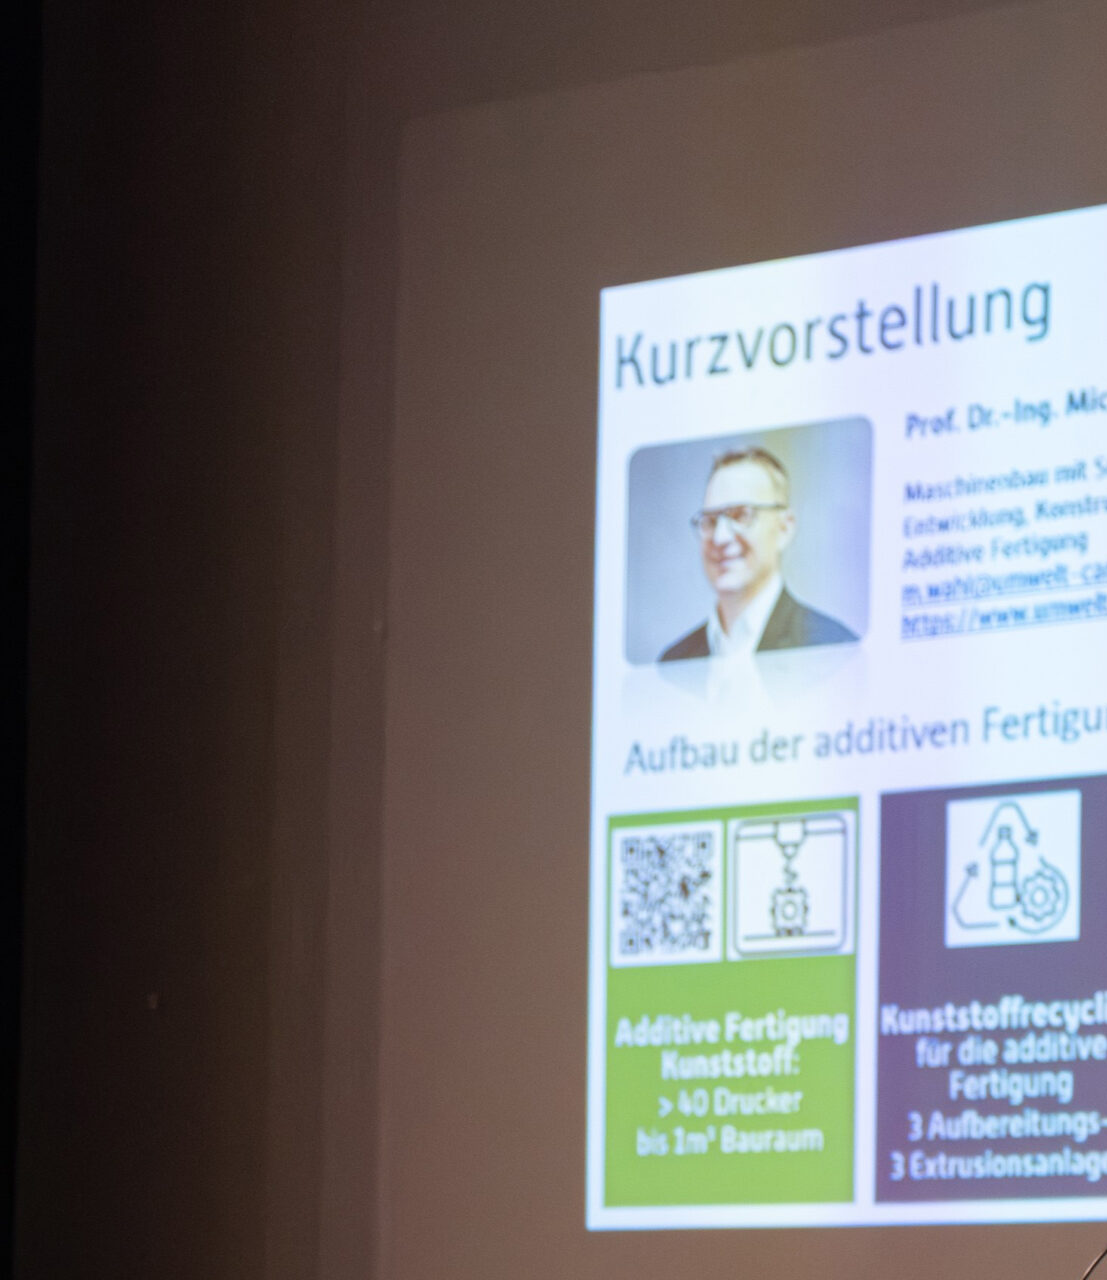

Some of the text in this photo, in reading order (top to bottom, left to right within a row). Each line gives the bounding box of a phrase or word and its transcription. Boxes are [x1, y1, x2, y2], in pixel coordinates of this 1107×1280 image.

[615, 282, 1050, 389] Kurzvorstellung
[905, 407, 959, 440] Prof.
[966, 398, 1058, 430] Dr.-Ing.
[905, 467, 1049, 502] Maschinenbau
[1054, 459, 1087, 483] mit
[903, 506, 1029, 538] Entwicklung,
[903, 530, 1089, 570] Additive Fertigung
[624, 735, 739, 776] Aufbau
[750, 728, 803, 764] der
[813, 713, 970, 758] additiven
[615, 1008, 849, 1048] Additive Fertigung
[661, 1044, 800, 1081] Kunststoff:
[915, 1036, 952, 1068] für
[957, 1034, 998, 1066] die
[677, 1088, 710, 1117] 40
[713, 1086, 803, 1116] Drucker
[949, 1067, 1074, 1106] Fertigung
[636, 1127, 670, 1157] bis
[720, 1124, 824, 1154] Bauraum
[907, 1110, 924, 1142] 3
[890, 1151, 906, 1182] 3
